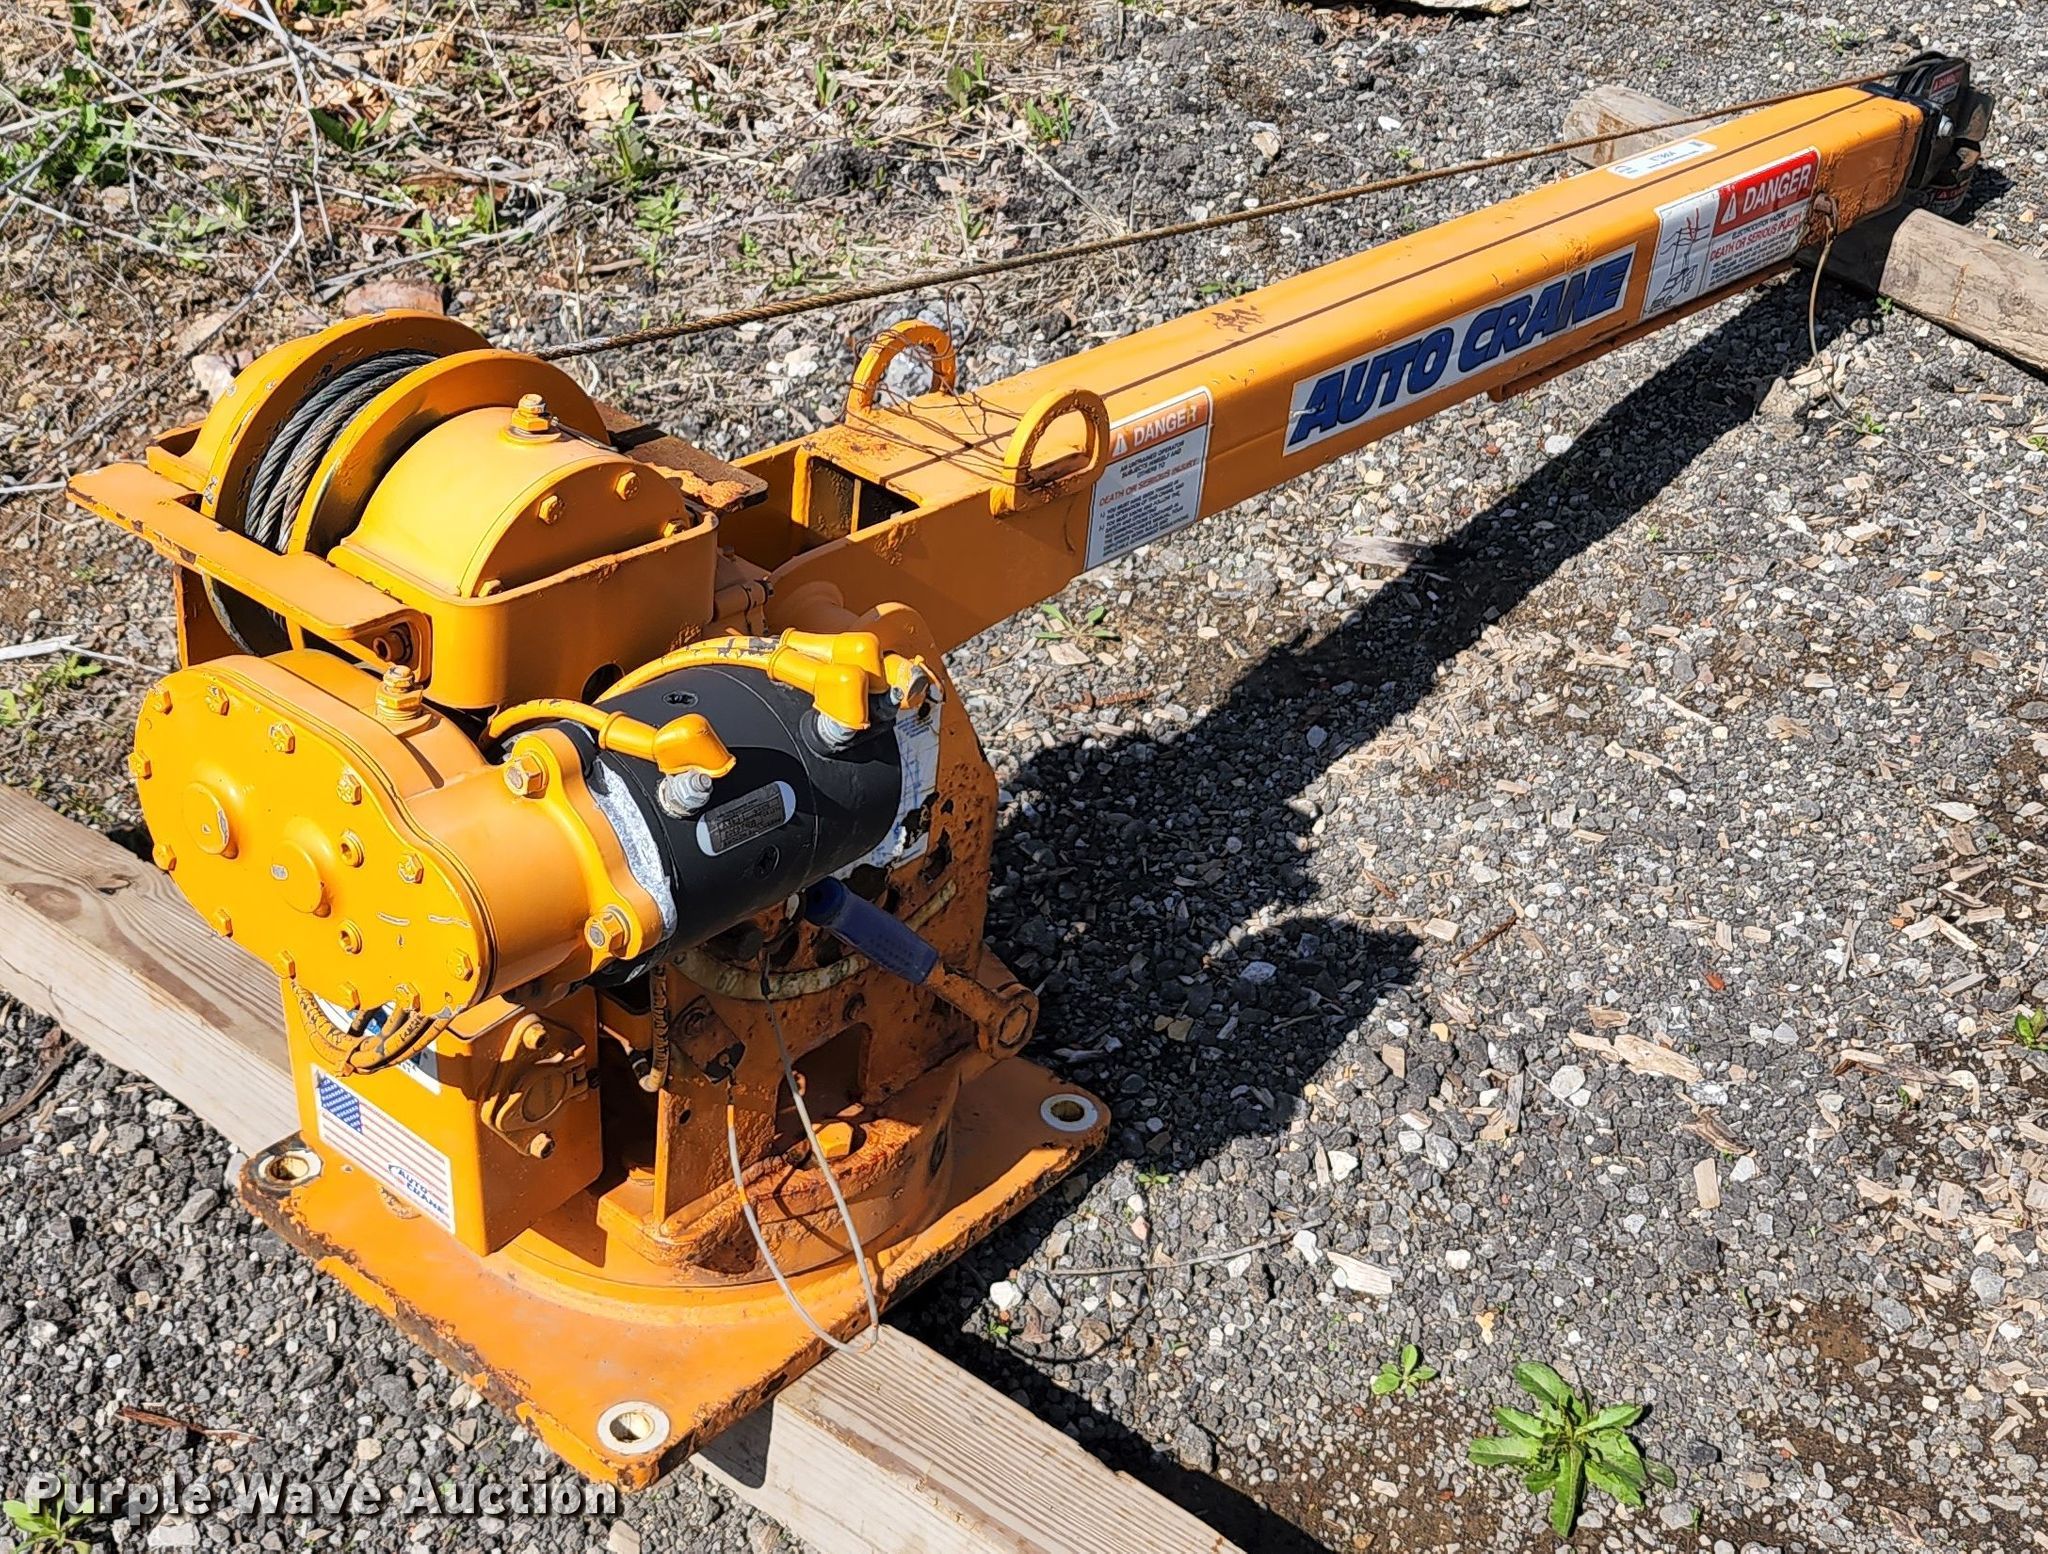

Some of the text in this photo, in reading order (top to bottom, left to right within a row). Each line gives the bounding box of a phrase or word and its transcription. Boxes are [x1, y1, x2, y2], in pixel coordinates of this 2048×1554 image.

[1742, 164, 1812, 214] DANGER
[1710, 242, 1735, 262] DEATH
[1736, 238, 1747, 251] OR
[1747, 222, 1777, 245] SERIOUS
[1287, 327, 1454, 447] AUTO
[1458, 252, 1634, 373] CRANE
[1133, 404, 1198, 447] DANGER
[1099, 489, 1124, 507] DEATH
[1126, 484, 1137, 495] OR
[398, 1169, 427, 1194] AUTO
[406, 1182, 445, 1214] CRANE
